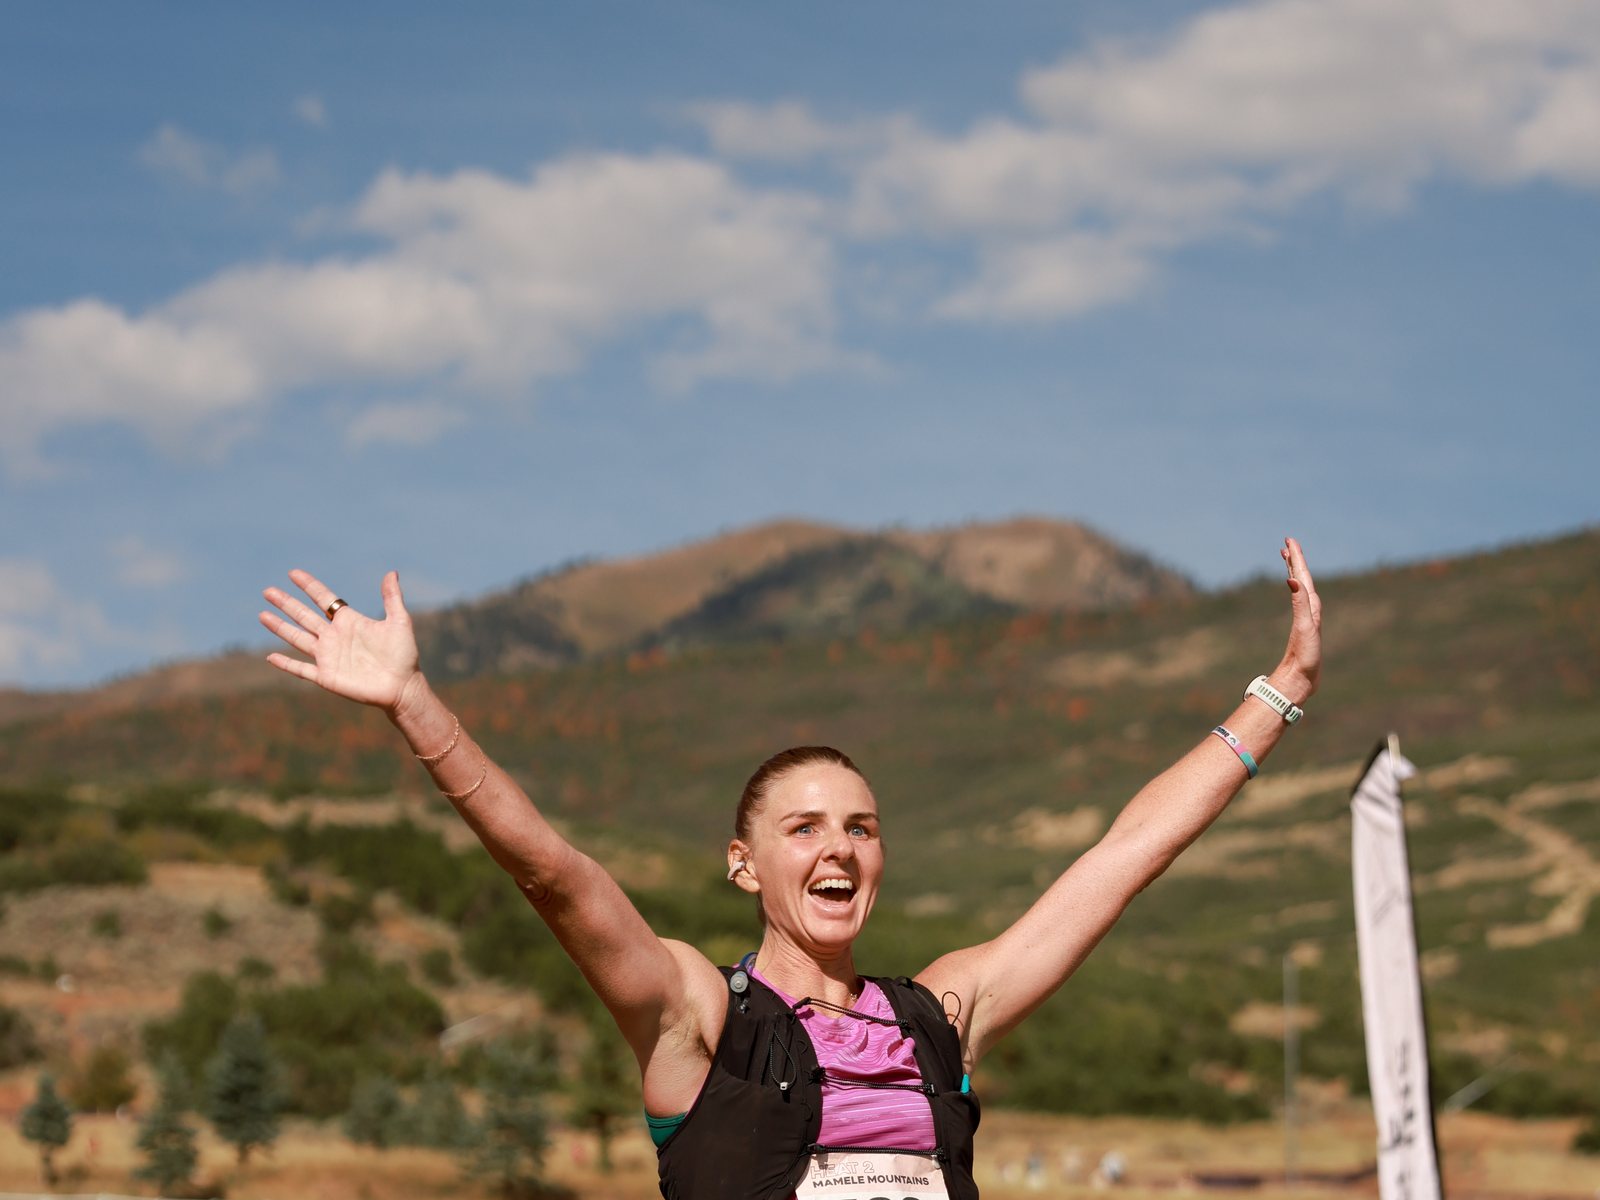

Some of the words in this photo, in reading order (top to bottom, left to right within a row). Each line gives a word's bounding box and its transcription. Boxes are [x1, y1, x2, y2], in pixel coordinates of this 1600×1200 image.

[810, 1161, 858, 1180] HEAT
[862, 1160, 875, 1174] 2
[812, 1175, 865, 1189] MAMELE
[867, 1174, 930, 1186] MOUNTAINS
